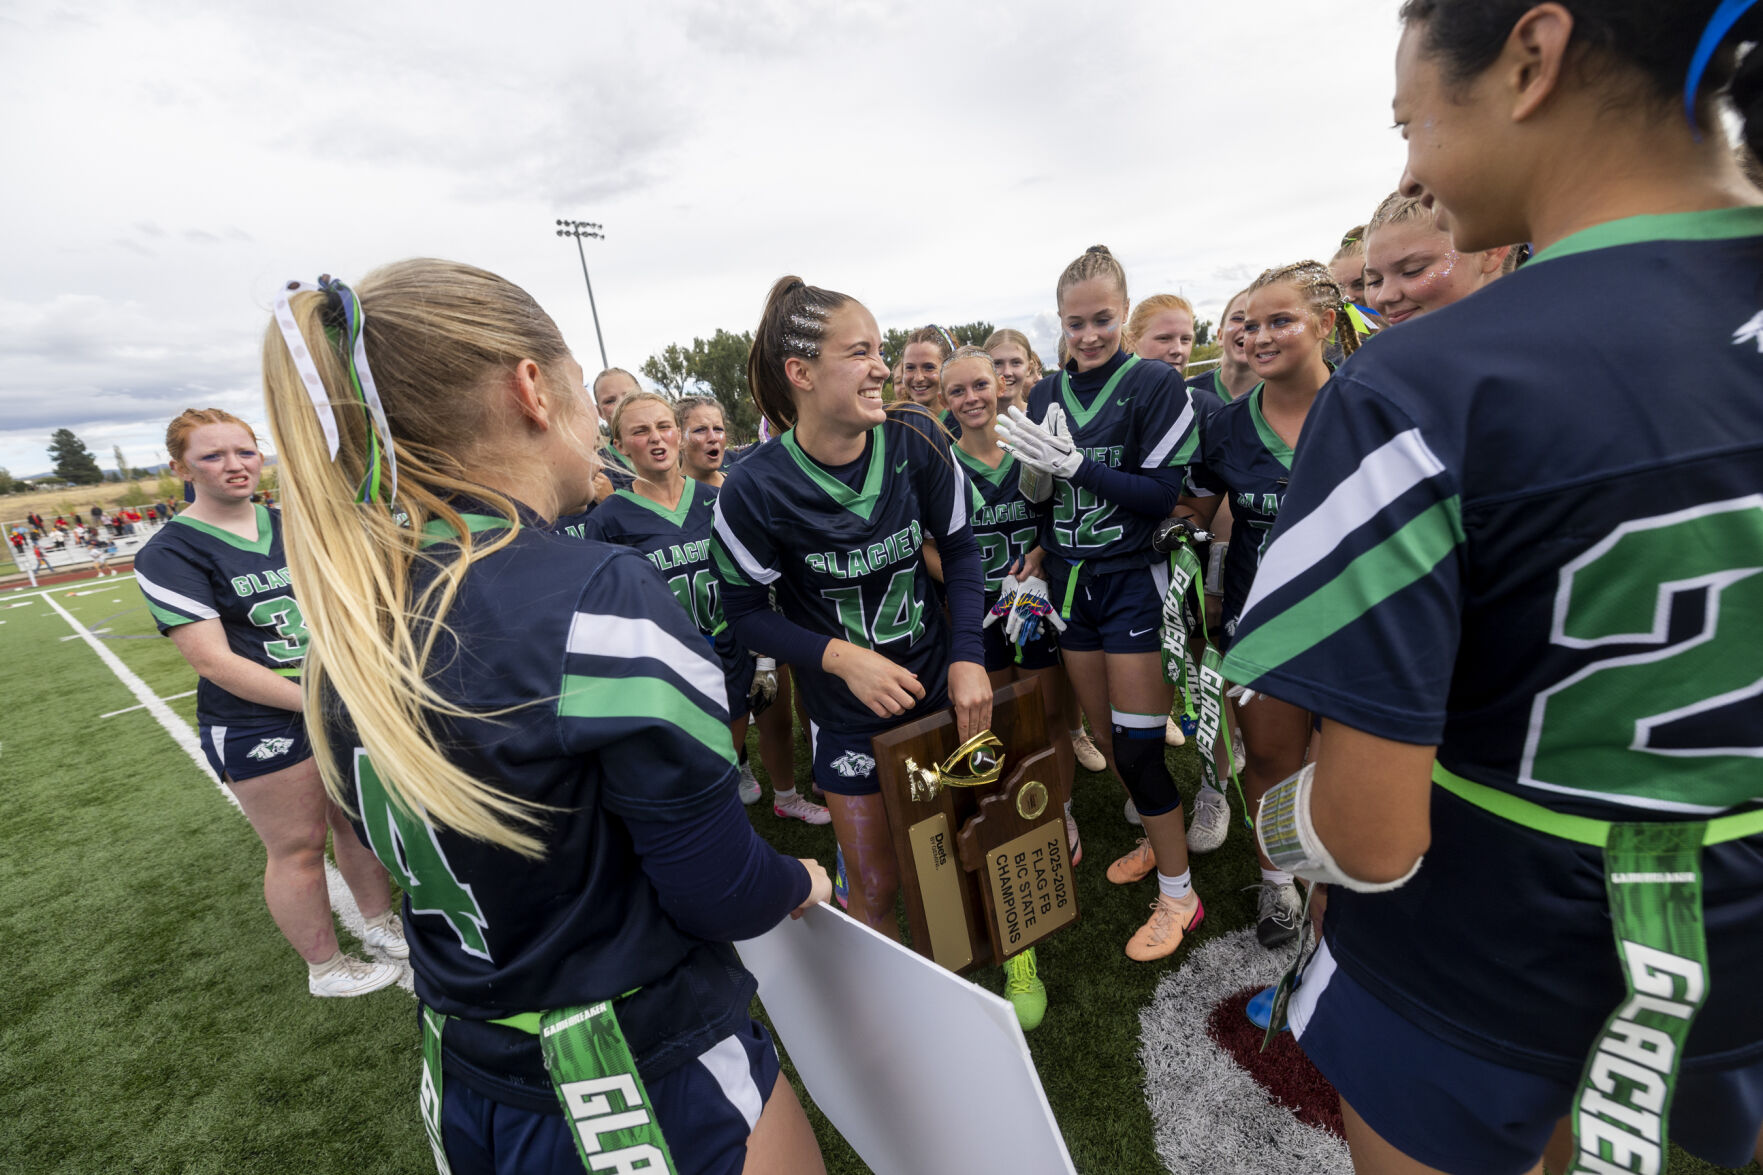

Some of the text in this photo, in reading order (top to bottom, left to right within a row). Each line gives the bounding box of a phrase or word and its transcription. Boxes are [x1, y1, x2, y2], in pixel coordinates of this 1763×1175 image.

[805, 519, 923, 579] GLACIER
[970, 500, 1044, 527] LACIE
[247, 595, 310, 662] 3
[820, 560, 926, 650] 14
[1163, 563, 1190, 659] GLACIER
[1517, 493, 1763, 814] 2
[1196, 664, 1223, 764] GLACIER
[354, 747, 494, 964] 4
[935, 832, 947, 866] Duets
[1014, 852, 1036, 928] B/C STATE
[1031, 848, 1051, 915] FLAG FB
[1047, 838, 1068, 909] 2025-2026
[996, 854, 1021, 944] CHAMPIONS
[1573, 939, 1705, 1175] GLACIE
